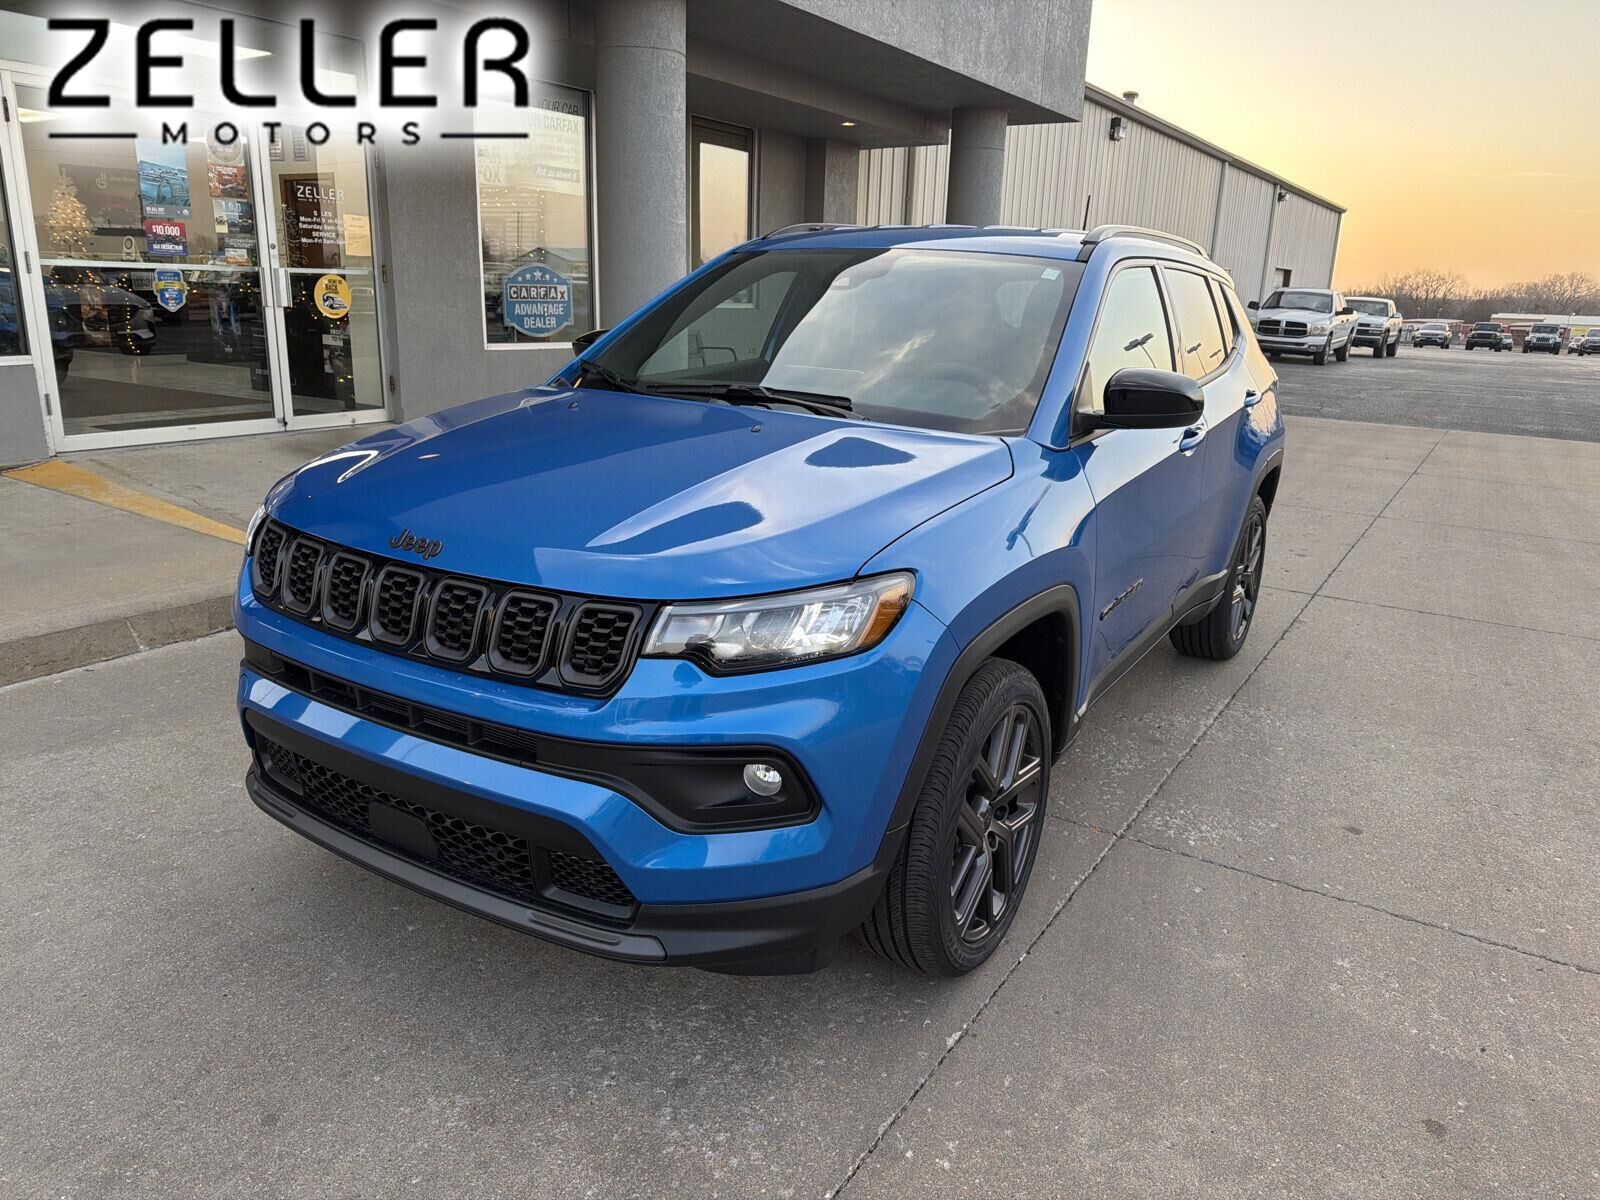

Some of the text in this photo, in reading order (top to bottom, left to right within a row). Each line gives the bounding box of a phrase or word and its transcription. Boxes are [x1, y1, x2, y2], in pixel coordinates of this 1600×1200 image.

[561, 102, 579, 116] CAR
[543, 114, 579, 134] CARFAX
[296, 185, 345, 201] ZELLER
[509, 286, 566, 300] CARFAX
[514, 303, 565, 315] ADVANTAGE
[523, 317, 557, 329] DEALER
[389, 528, 444, 560] Jeep
